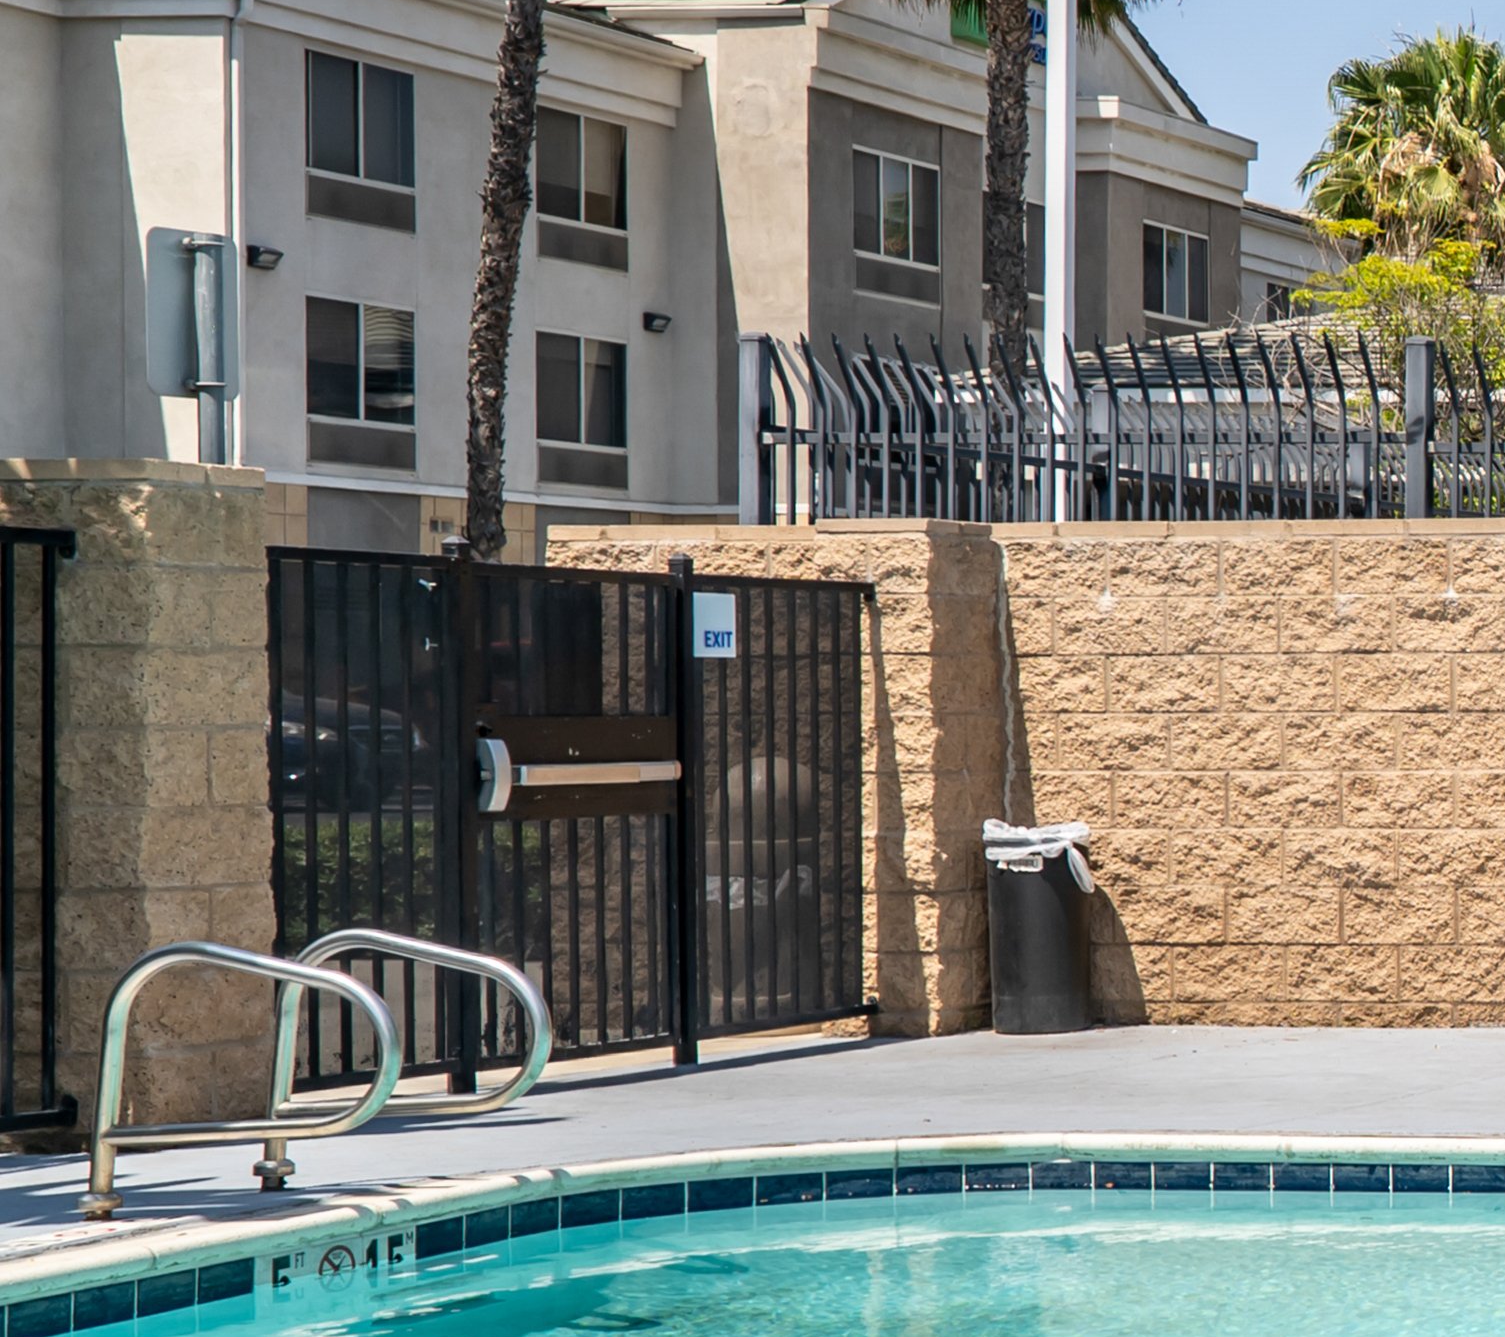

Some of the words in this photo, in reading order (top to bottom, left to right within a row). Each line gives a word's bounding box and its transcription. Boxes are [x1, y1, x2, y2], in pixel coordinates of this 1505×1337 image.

[704, 630, 733, 648] EXIT
[405, 1231, 414, 1245] M
[294, 1251, 305, 1269] FT
